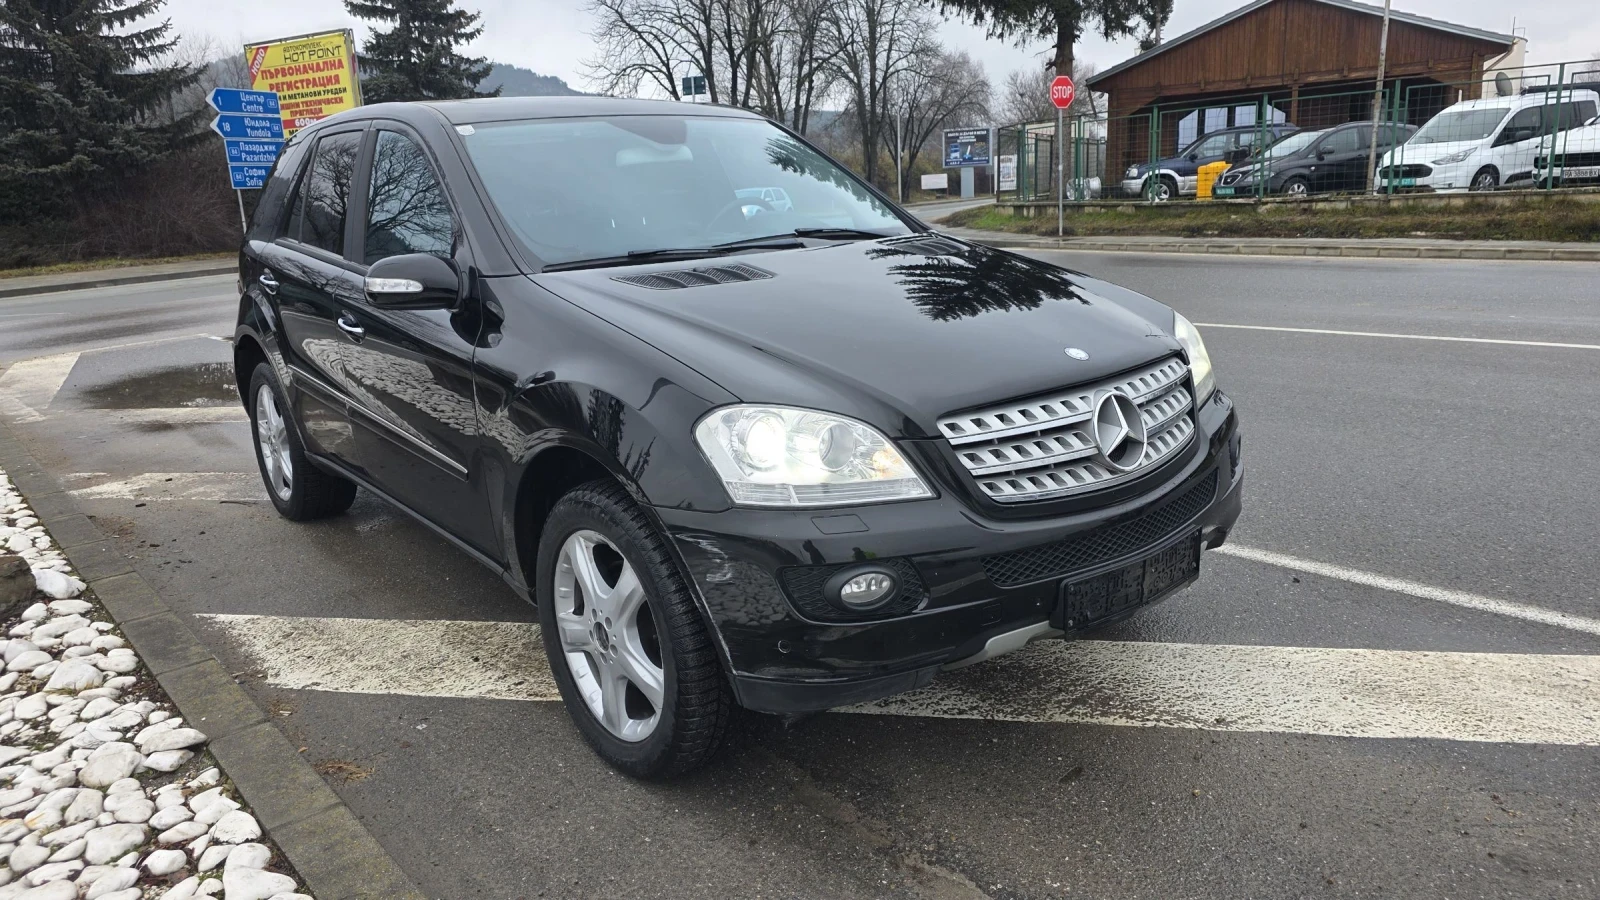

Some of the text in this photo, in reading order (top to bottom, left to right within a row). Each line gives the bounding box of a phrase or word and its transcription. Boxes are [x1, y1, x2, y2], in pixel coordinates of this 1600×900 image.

[283, 42, 322, 53] АВТОКОМПЛЕКС
[284, 46, 342, 63] HOT POINT
[252, 48, 265, 75] НОВО
[260, 58, 344, 80] ПЪРВОНАЧАЛНА
[268, 74, 340, 92] РЕГИСТРАЦИЯ
[240, 92, 264, 102] Център
[288, 91, 322, 100] МЕТАНОВИ
[322, 87, 347, 96] УРЕДБИ
[1052, 86, 1072, 98] STOP
[218, 96, 222, 106] 1
[242, 103, 264, 112] Centre
[222, 122, 230, 132] 18
[244, 118, 270, 127] Юндола
[246, 128, 271, 137] Yundola
[240, 142, 276, 152] Пазарджик
[242, 153, 276, 162] Pazardzhik
[244, 167, 265, 176] София
[246, 176, 262, 186] Sofia
